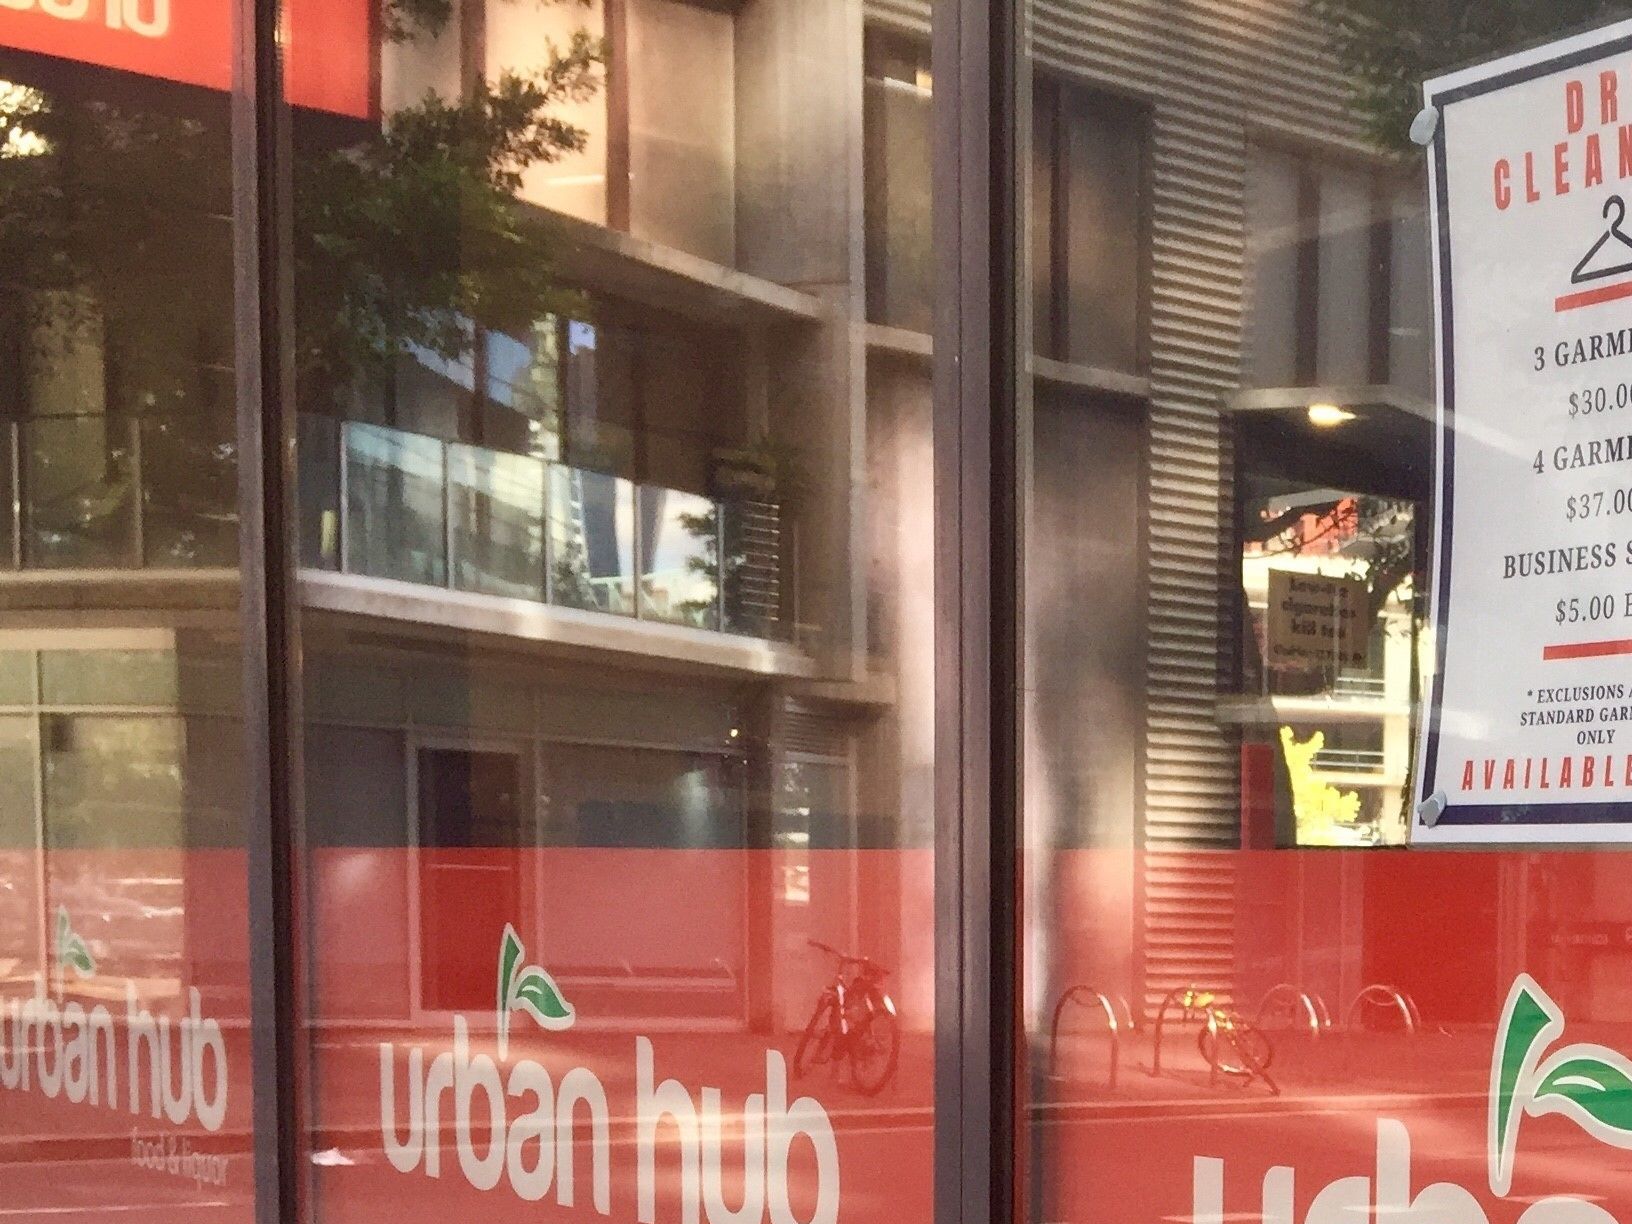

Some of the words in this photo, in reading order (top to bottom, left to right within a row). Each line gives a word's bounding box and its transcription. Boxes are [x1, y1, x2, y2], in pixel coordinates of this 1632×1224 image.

[1533, 346, 1546, 371] 3
[1532, 450, 1545, 474] 4
[1503, 542, 1616, 579] BUSINESS
[1555, 595, 1615, 626] $5.00
[1520, 708, 1595, 726] STANDARD
[1576, 729, 1616, 746] ONLY
[0, 972, 117, 1110] urban
[126, 978, 228, 1133] hub
[380, 1014, 610, 1215] urban
